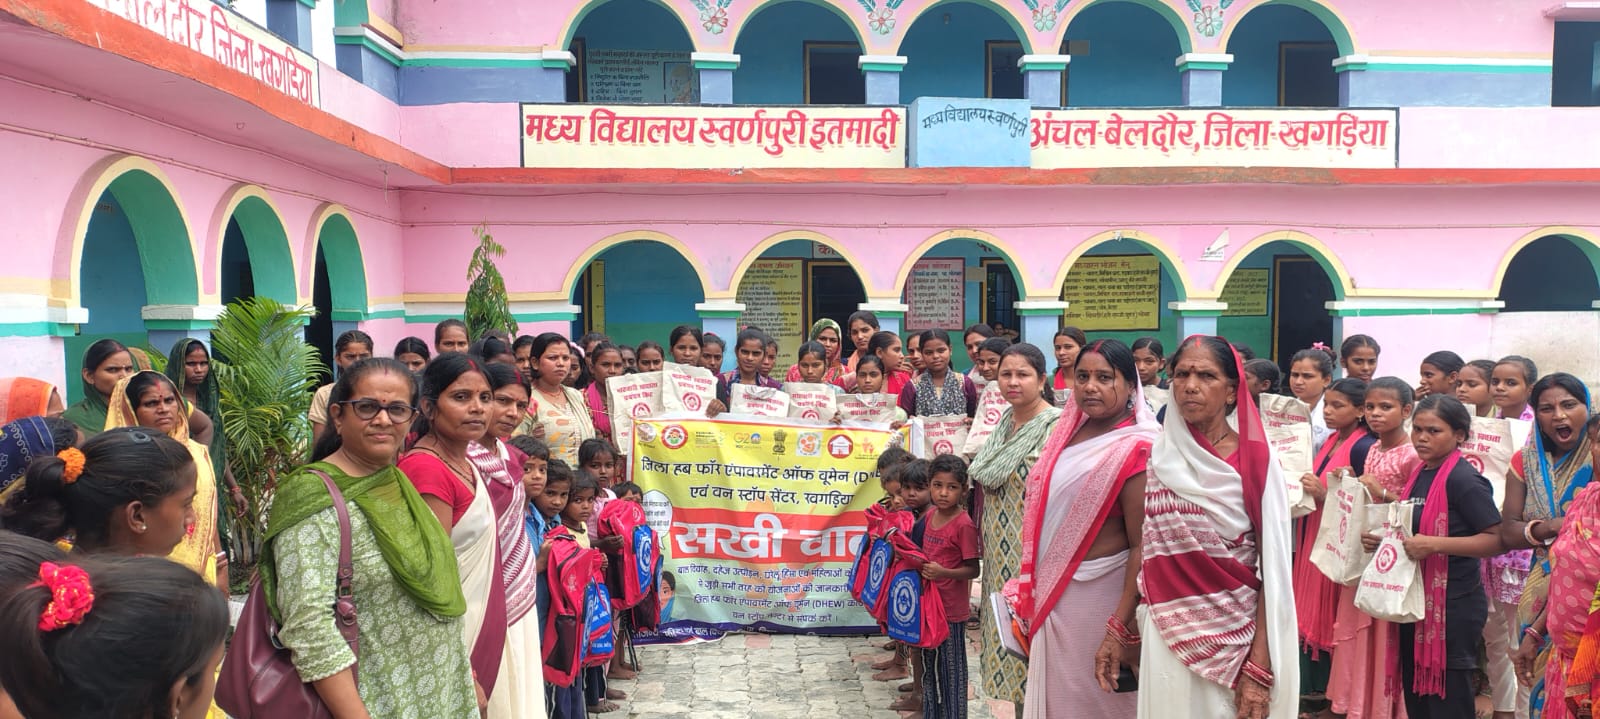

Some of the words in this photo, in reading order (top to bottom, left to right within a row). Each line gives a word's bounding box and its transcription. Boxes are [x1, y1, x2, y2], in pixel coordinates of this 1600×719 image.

[526, 113, 585, 144] मध्य
[589, 108, 698, 146] विद्यालय
[698, 109, 809, 156] स्वर्णपुरी
[810, 108, 901, 150] इतमादी
[641, 456, 670, 474] जिला
[673, 463, 692, 476] हब
[696, 460, 722, 474] फॉर
[782, 466, 815, 480] ऑफ
[818, 468, 850, 485] वूमेन
[690, 484, 709, 498] एवं
[712, 486, 734, 500] वन
[738, 486, 766, 501] स्टॉप
[769, 488, 800, 505] सेंटर,
[804, 490, 856, 508] खगड़िया
[672, 513, 788, 558] सखी
[812, 600, 845, 609] (DHEW)
